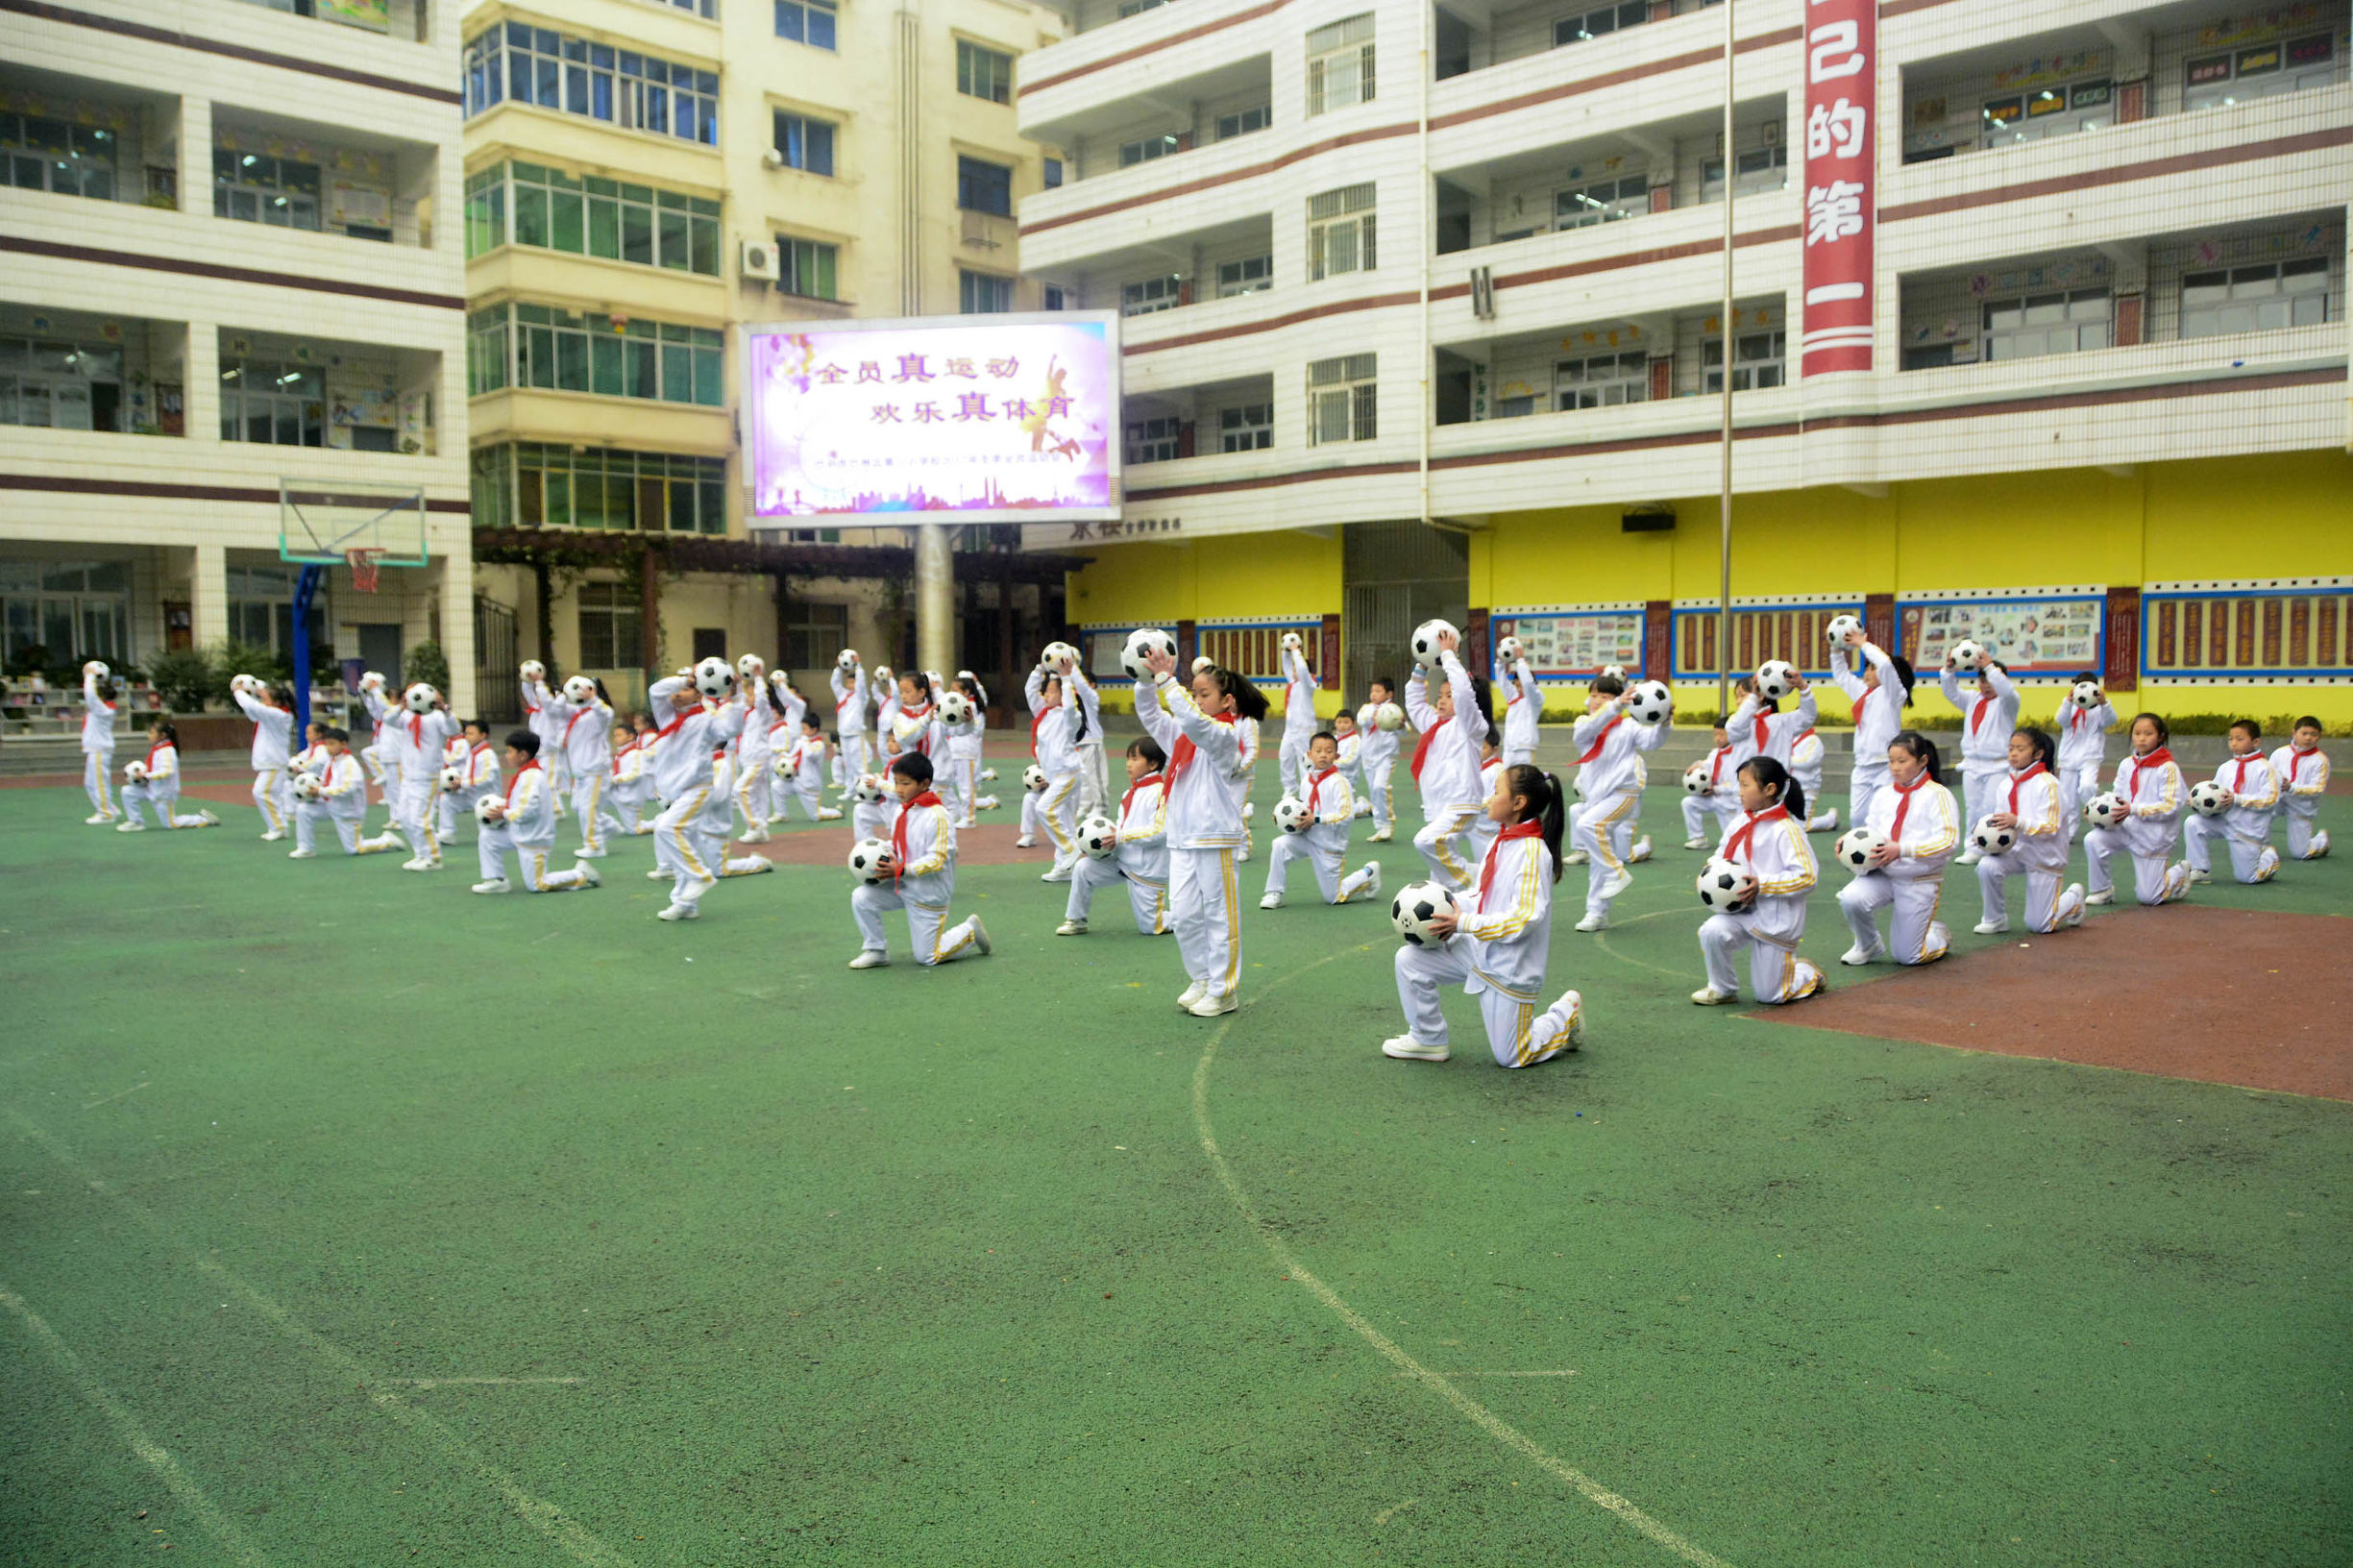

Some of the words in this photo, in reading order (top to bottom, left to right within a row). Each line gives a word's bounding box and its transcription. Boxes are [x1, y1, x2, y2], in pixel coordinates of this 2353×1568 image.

[1806, 0, 1866, 306] 己的第一
[815, 352, 1019, 384] 全员真运动
[870, 390, 1076, 424] 欢乐真体育
